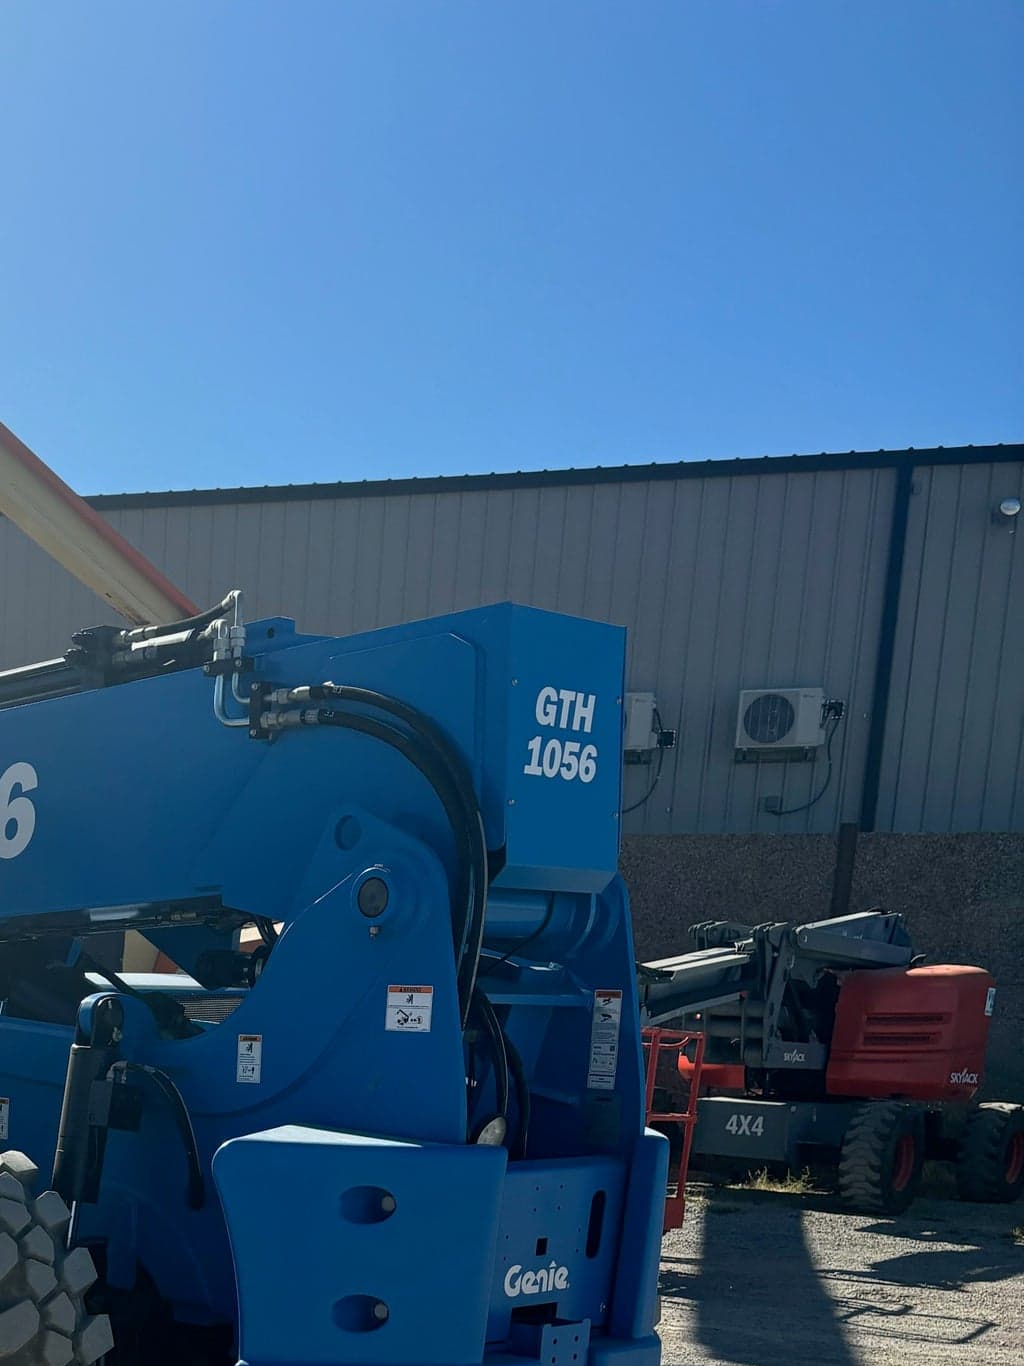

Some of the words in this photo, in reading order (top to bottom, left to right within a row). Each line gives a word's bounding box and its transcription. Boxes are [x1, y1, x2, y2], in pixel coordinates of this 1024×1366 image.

[535, 686, 597, 733] GTH
[523, 735, 598, 783] 1056
[725, 1114, 764, 1136] 4X4
[504, 1260, 569, 1297] Genie
